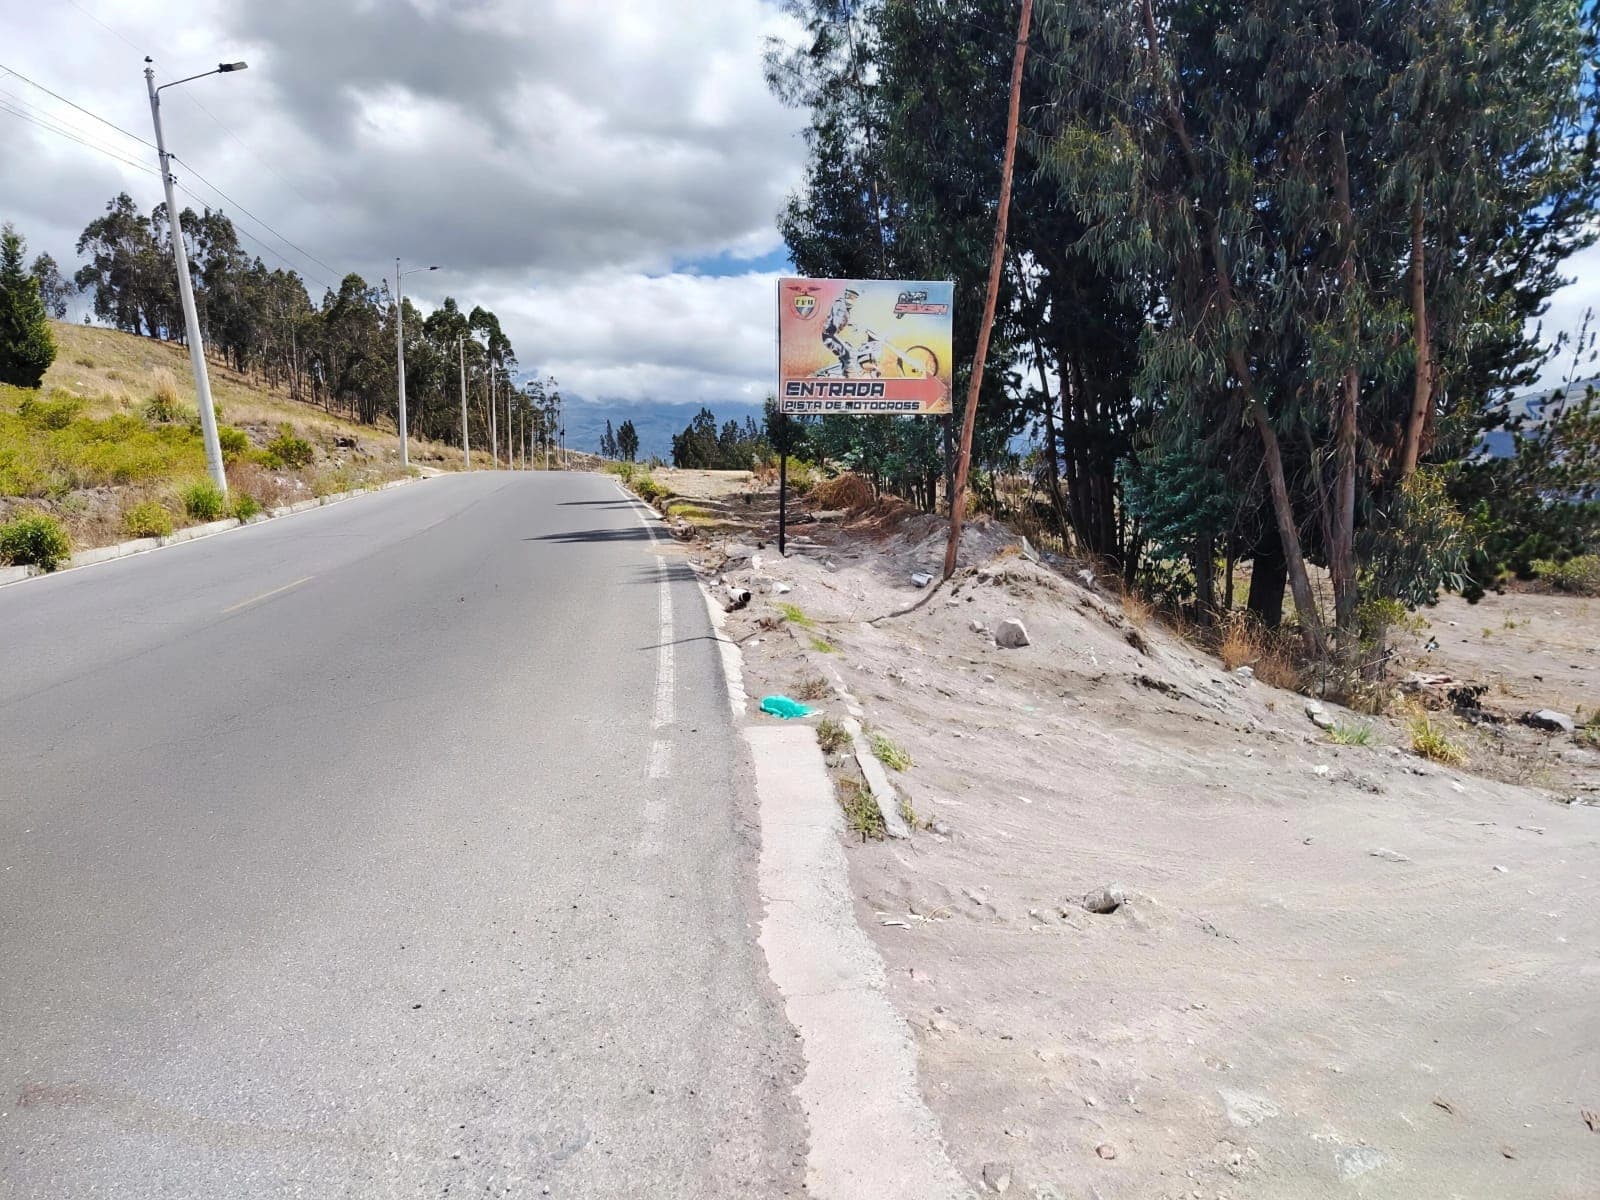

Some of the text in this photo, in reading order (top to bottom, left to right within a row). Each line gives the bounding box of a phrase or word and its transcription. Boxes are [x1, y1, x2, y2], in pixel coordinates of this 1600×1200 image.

[786, 381, 885, 397] ENTRADA
[785, 400, 921, 410] PISTA DE MOTOCROSS
